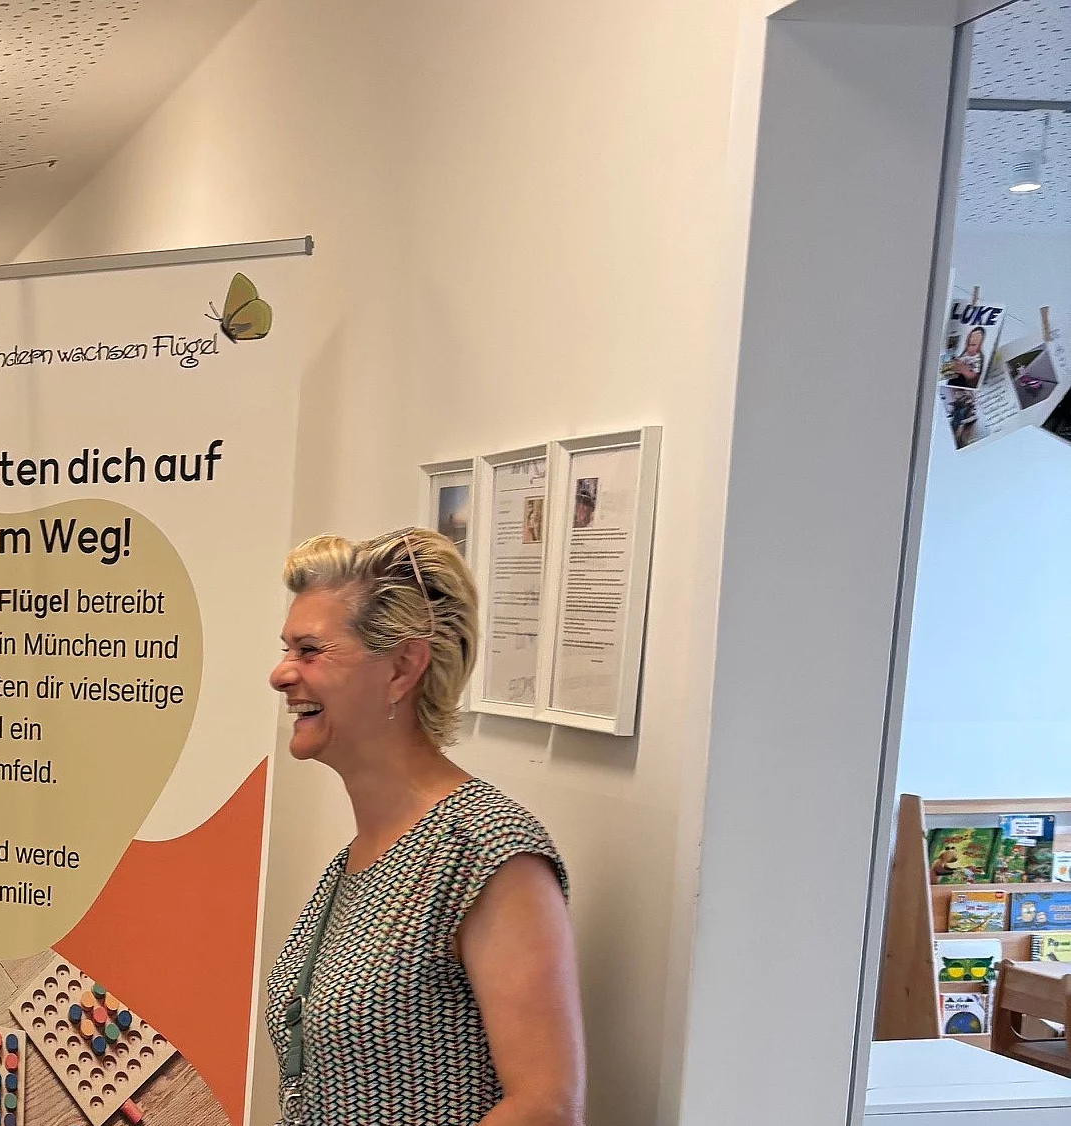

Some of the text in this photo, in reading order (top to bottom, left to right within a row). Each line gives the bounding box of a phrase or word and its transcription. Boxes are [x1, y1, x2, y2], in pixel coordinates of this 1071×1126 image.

[951, 302, 1003, 326] LUKE
[56, 341, 148, 363] wachsen
[152, 332, 220, 369] Flügel
[67, 446, 146, 485] dich
[154, 439, 224, 483] auf
[39, 517, 132, 566] Weg!
[76, 588, 165, 615] betreibt
[24, 632, 126, 658] München
[135, 634, 179, 660] und
[36, 675, 65, 700] dir
[69, 676, 184, 710] vielseitige
[10, 717, 42, 741] ein
[15, 844, 80, 869] werde
